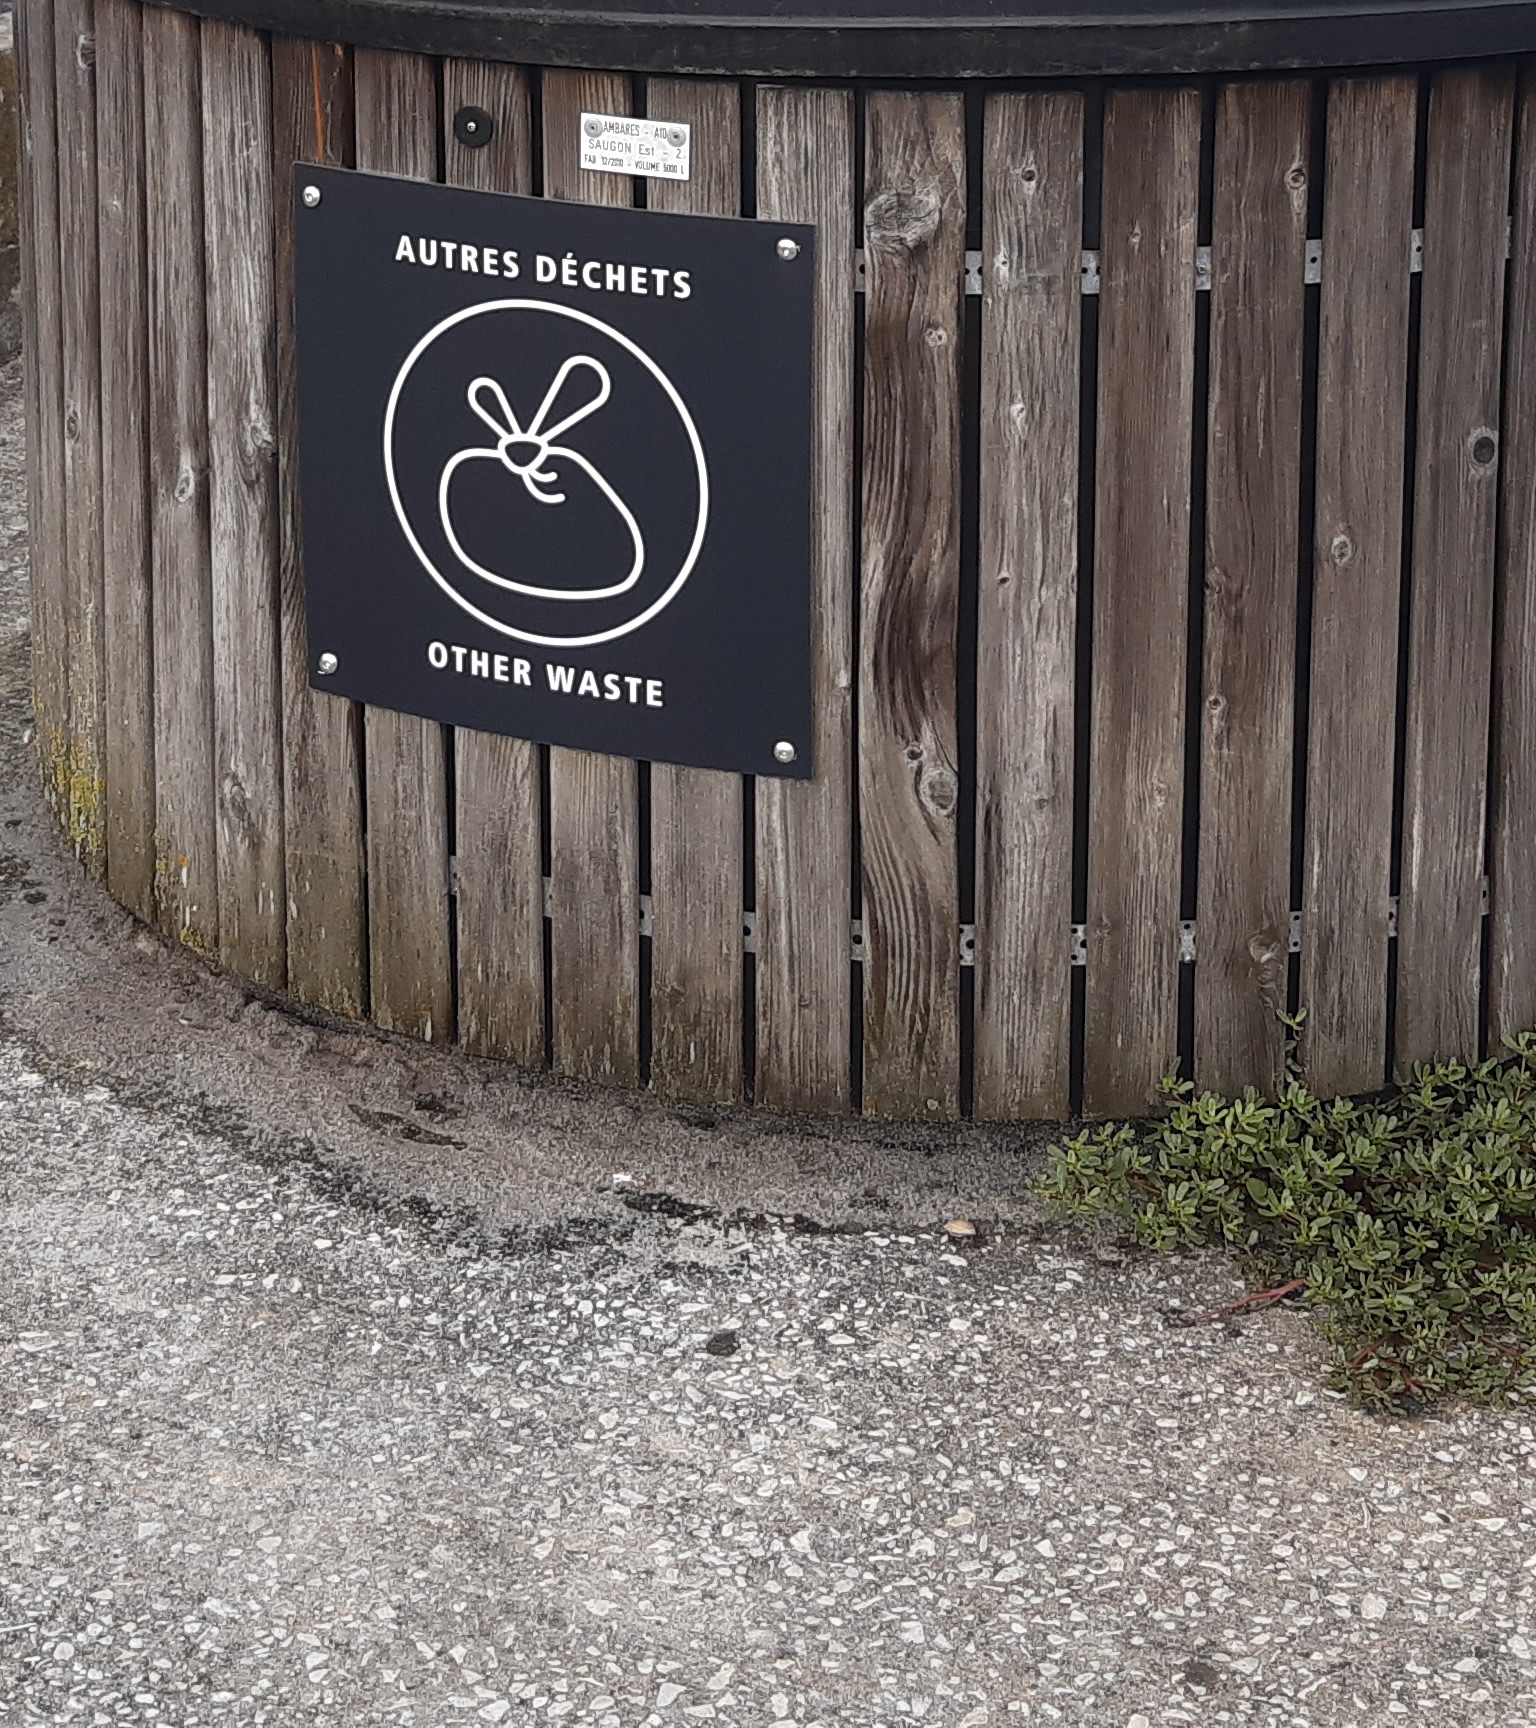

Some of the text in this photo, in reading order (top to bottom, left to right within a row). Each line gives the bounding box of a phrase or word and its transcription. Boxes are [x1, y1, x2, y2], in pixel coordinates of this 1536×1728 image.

[589, 138, 632, 154] SAUGON
[638, 144, 655, 156] Est
[676, 148, 682, 159] 2
[635, 160, 660, 172] VOLUME
[395, 234, 693, 299] AUTRES DÉCHETS
[428, 641, 664, 707] OTHER WASTE
